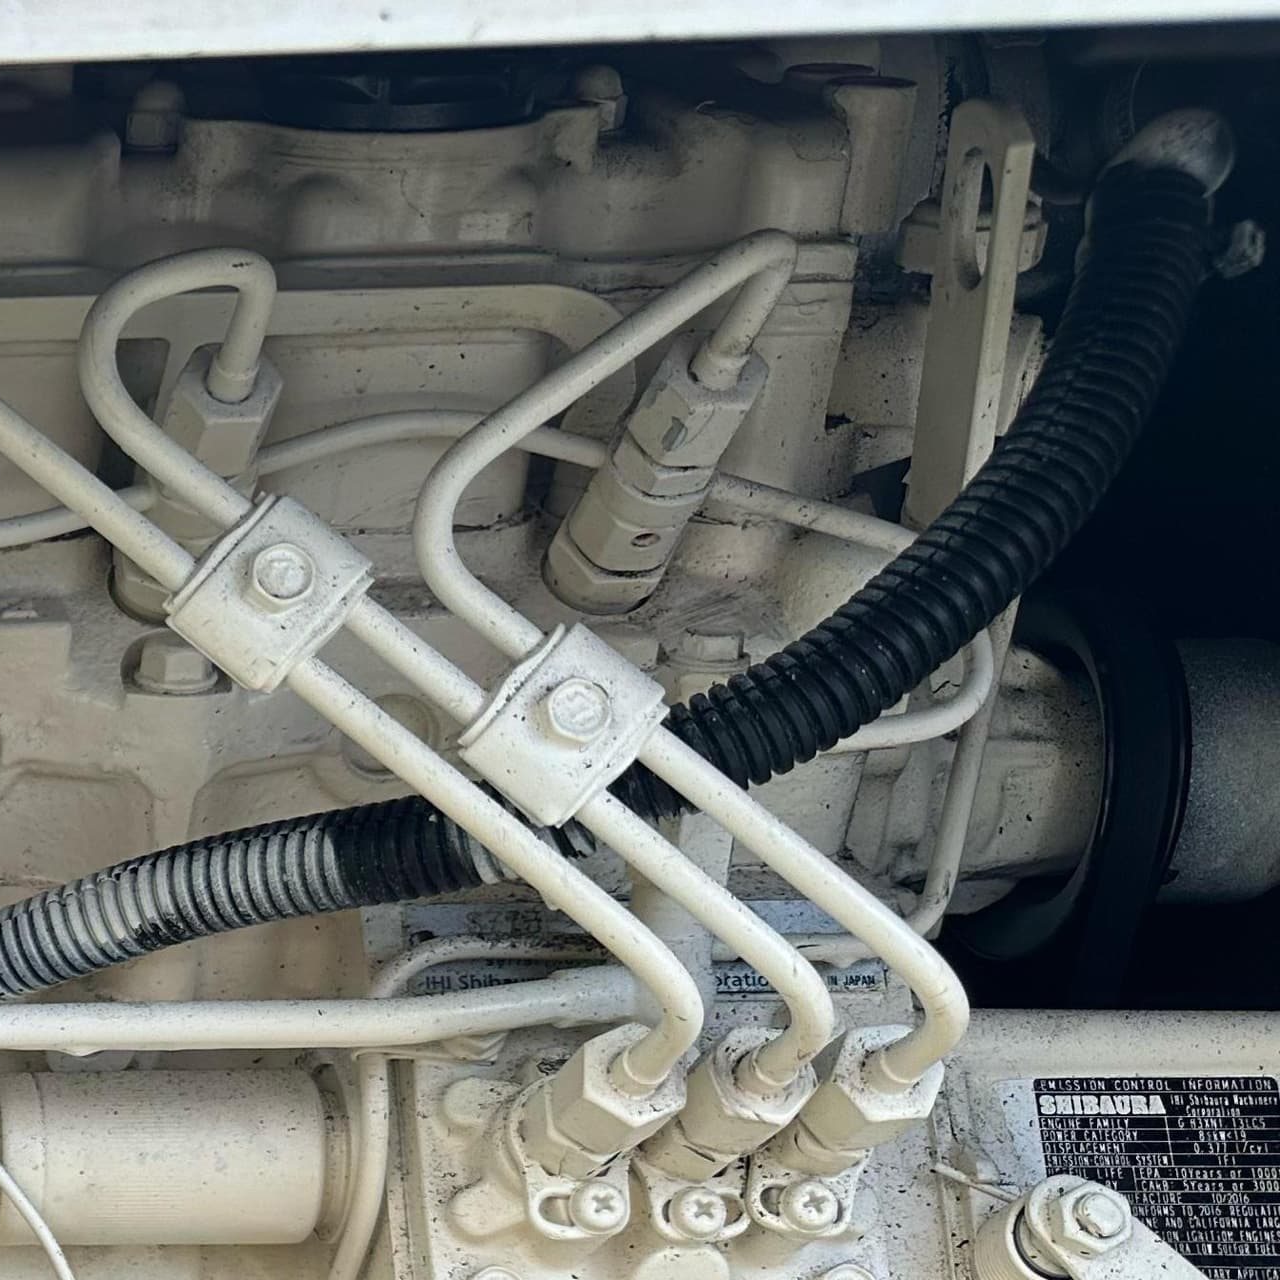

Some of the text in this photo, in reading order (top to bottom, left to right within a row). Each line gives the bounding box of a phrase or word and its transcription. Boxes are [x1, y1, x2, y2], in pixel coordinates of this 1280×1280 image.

[843, 974, 876, 987] JAPAN
[1040, 1079, 1272, 1091] EMISSION CONTROL INFORMATION
[1039, 1095, 1167, 1115] SHIBAURA
[1189, 1094, 1230, 1106] Shibaura
[1186, 1105, 1240, 1117] Corporation
[1040, 1118, 1130, 1130] ENGINE FAMILY
[1042, 1131, 1138, 1141] POWER CATEGORY
[1043, 1142, 1127, 1154] DISPLACEMENT
[1135, 1154, 1169, 1165] SYSTEM
[1097, 1167, 1125, 1179] LIFE
[1229, 1169, 1242, 1178] or
[1232, 1182, 1244, 1191] or
[1211, 1192, 1250, 1204] 10/2016
[1132, 1205, 1280, 1217] ONFORMS TO 2016 REGULATI
[1165, 1217, 1184, 1229] AND
[1189, 1217, 1251, 1229] CALIFORNIA
[1256, 1217, 1280, 1229] LARG
[1186, 1230, 1234, 1242] IGNITION
[1255, 1243, 1277, 1254] FUEL
[1237, 1269, 1280, 1280] APPLICA
